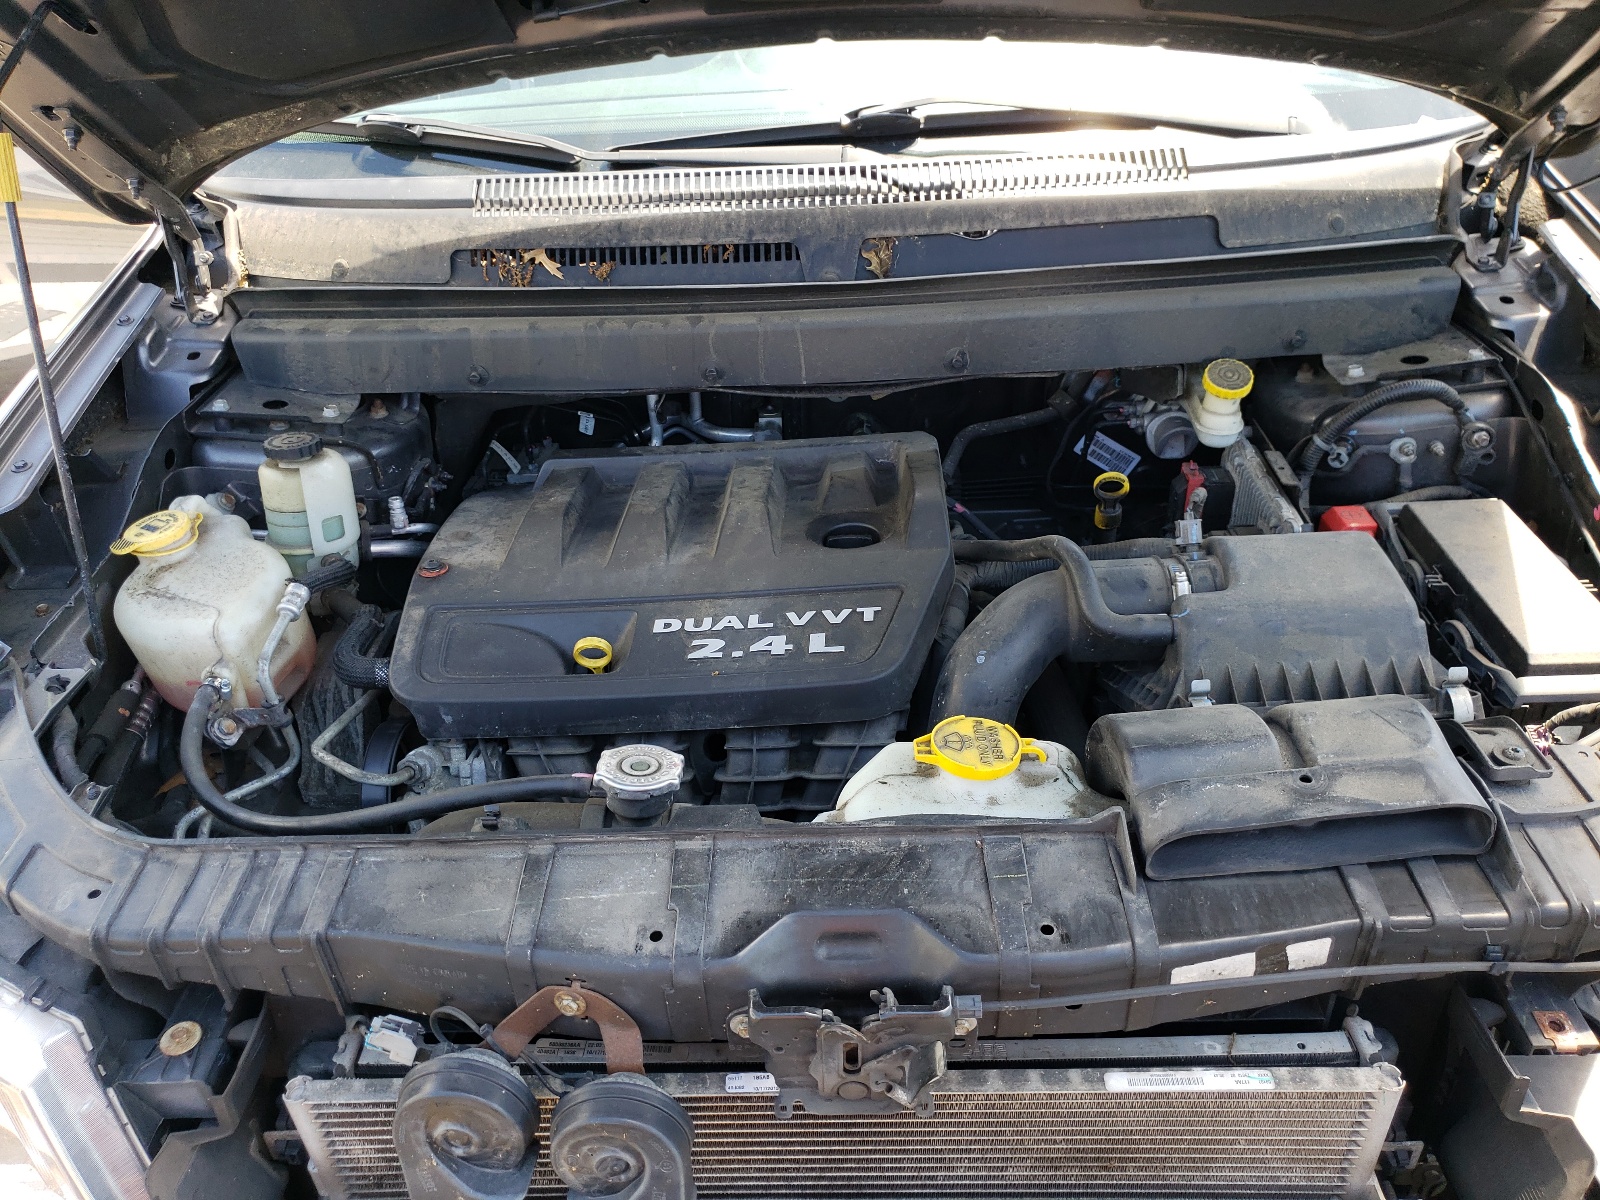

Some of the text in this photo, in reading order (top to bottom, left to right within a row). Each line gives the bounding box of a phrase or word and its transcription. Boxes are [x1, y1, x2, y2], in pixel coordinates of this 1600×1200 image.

[652, 606, 882, 633] DUAL VVT
[687, 632, 846, 660] 2.4 L
[986, 725, 1004, 761] WASHER
